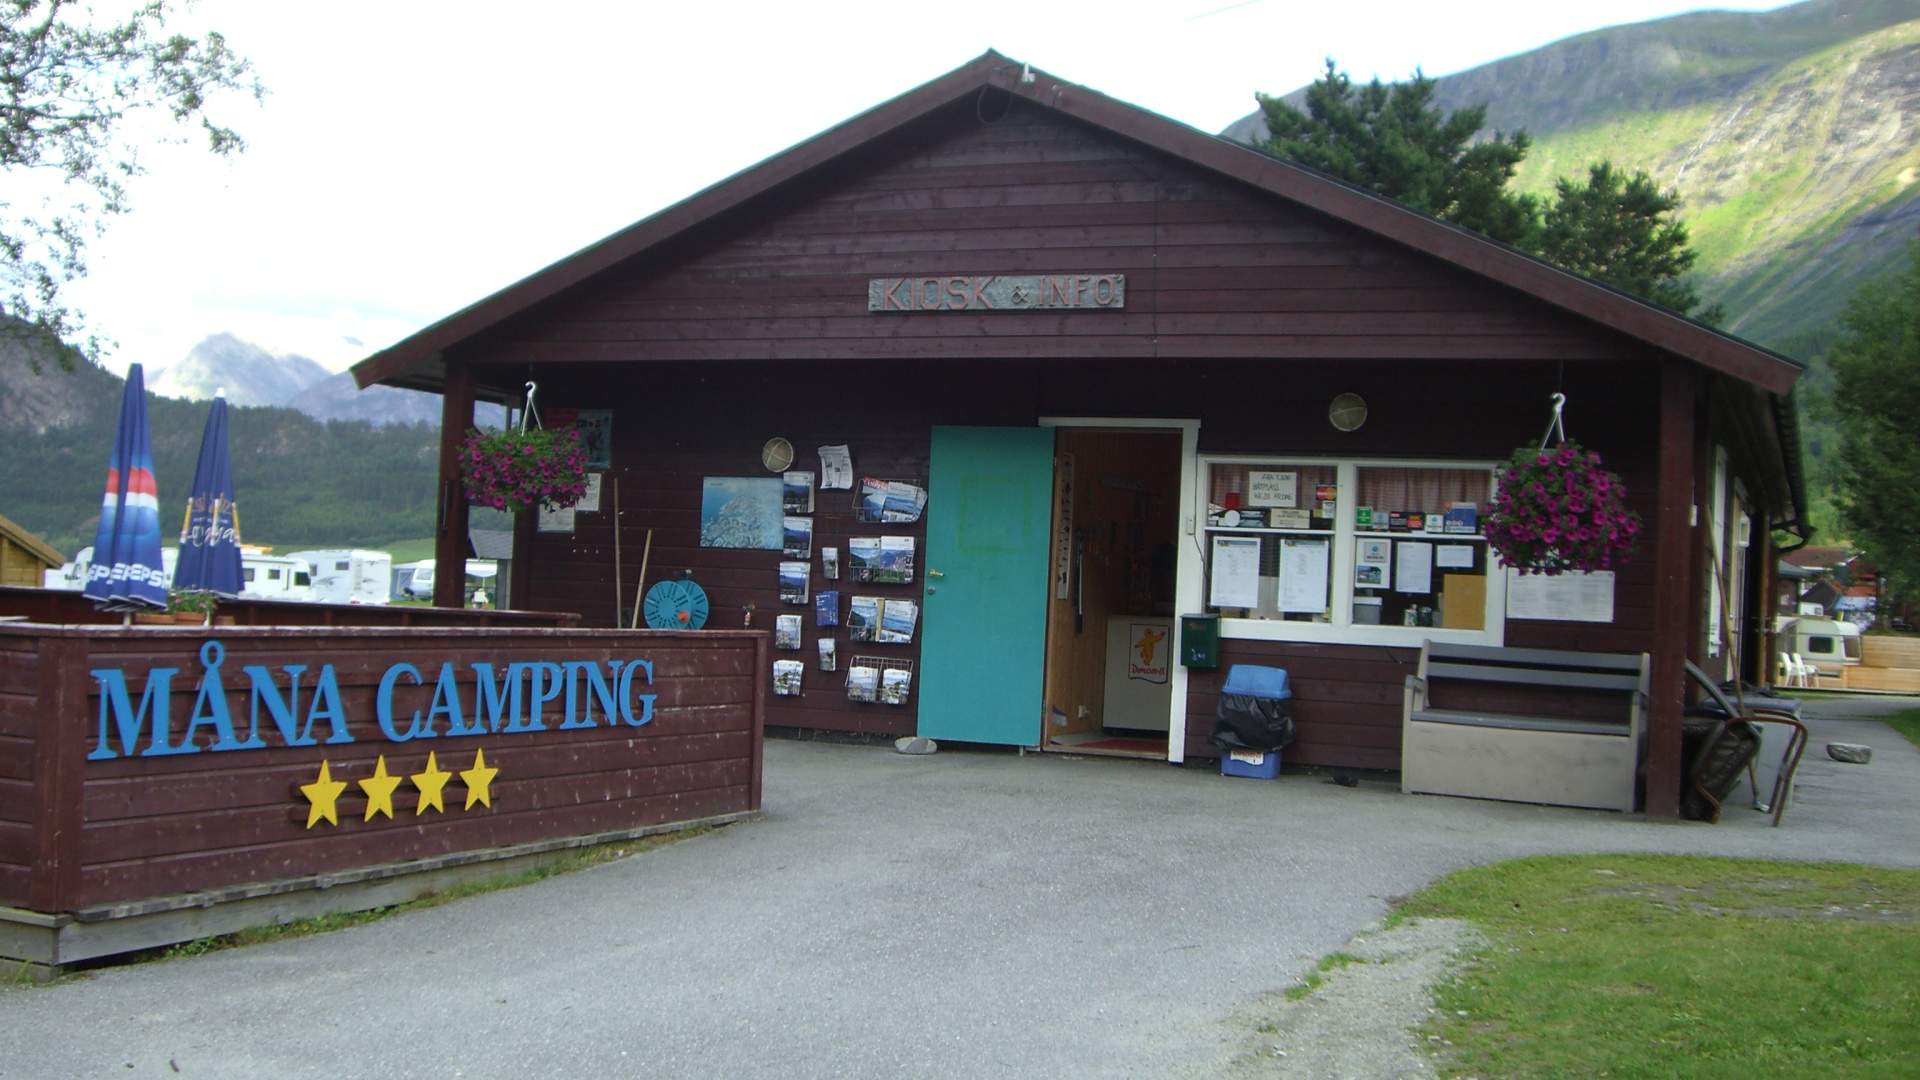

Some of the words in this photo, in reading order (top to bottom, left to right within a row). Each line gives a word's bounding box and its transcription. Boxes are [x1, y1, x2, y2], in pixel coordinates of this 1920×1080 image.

[883, 275, 994, 310] KIOSK
[1010, 284, 1029, 305] &
[1038, 275, 1116, 306] INFO
[87, 640, 355, 760] MÅNA
[376, 659, 656, 742] CAMPING
